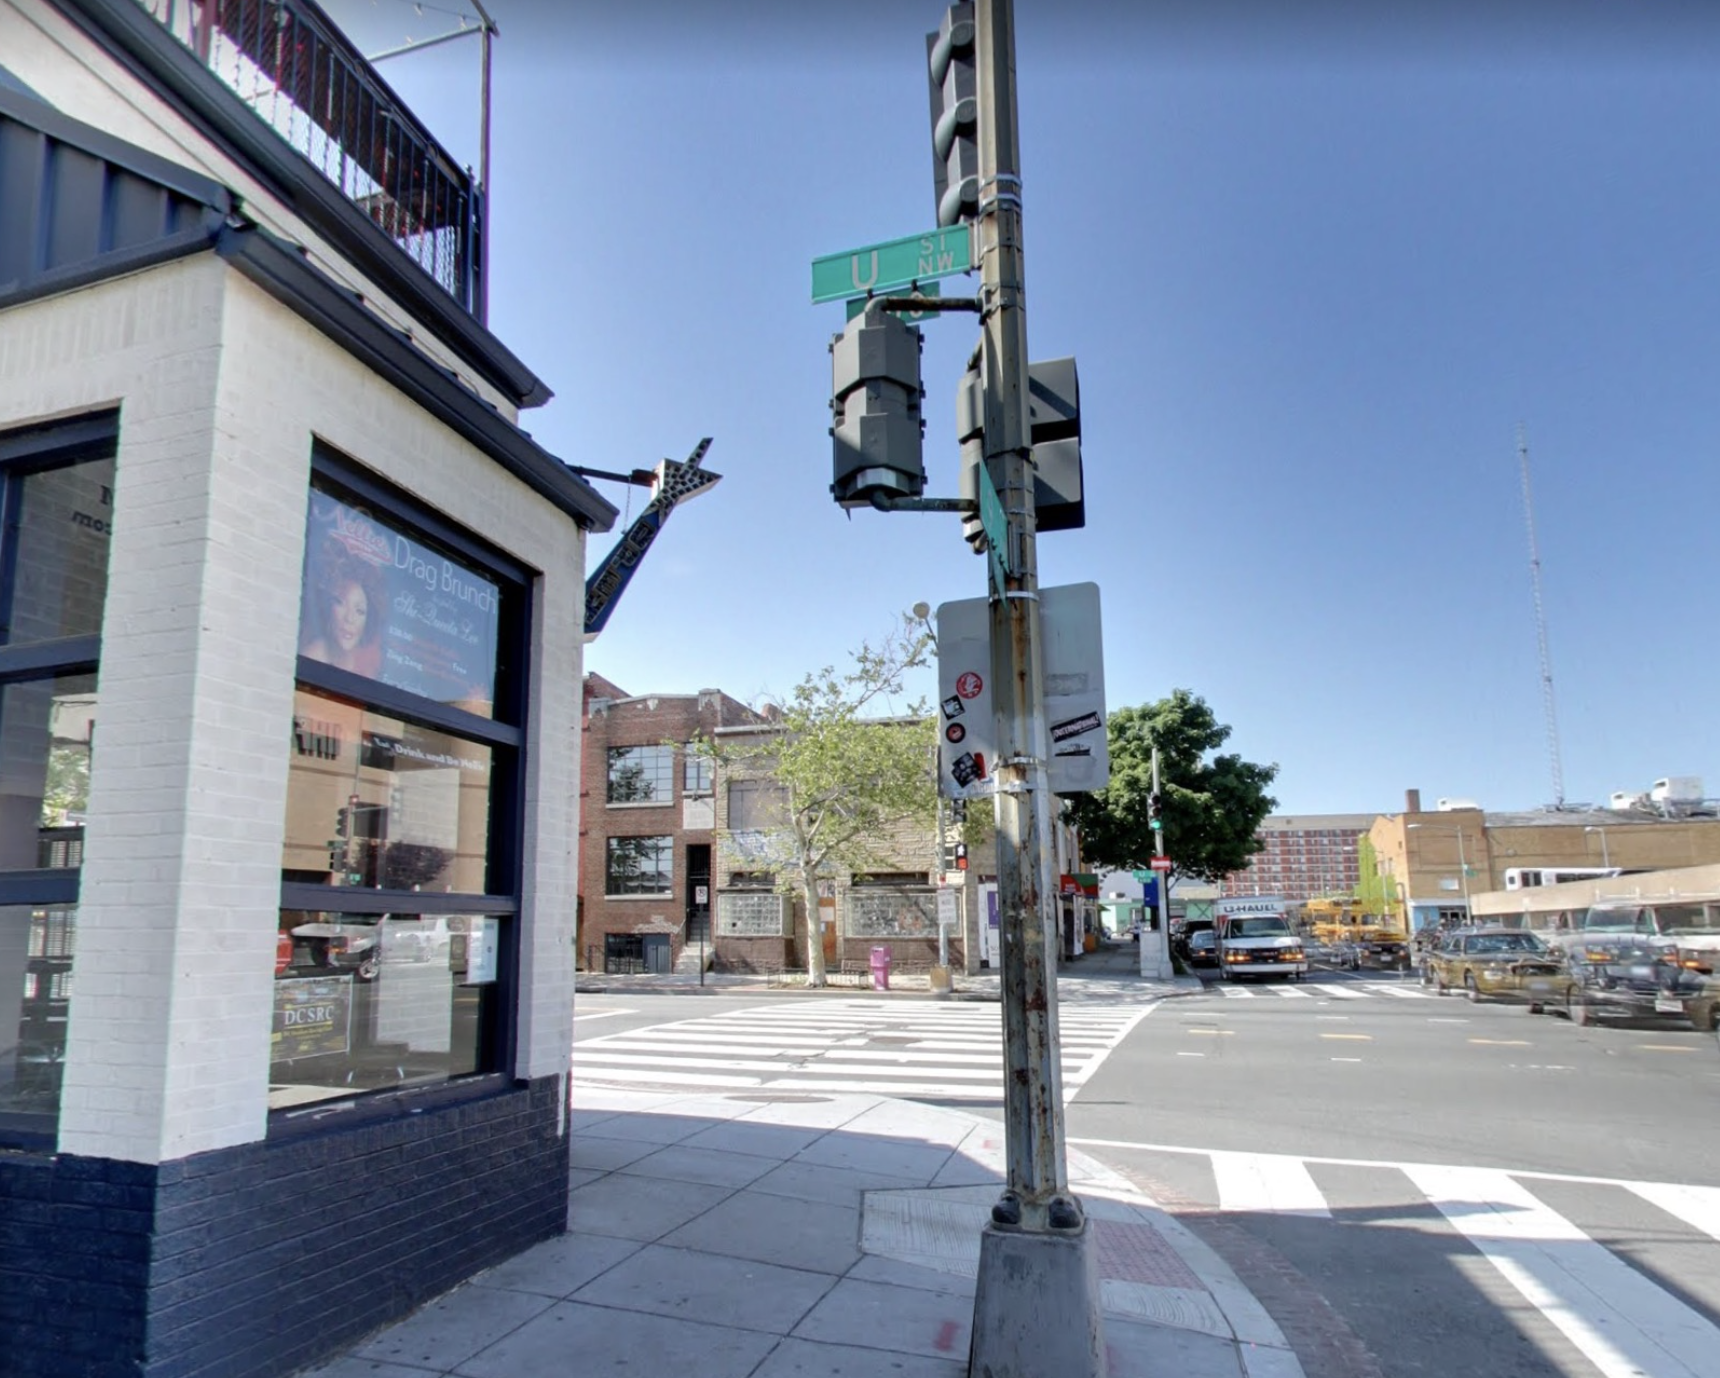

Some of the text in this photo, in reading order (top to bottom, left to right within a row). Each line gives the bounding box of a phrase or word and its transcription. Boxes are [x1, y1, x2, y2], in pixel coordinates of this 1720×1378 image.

[852, 250, 878, 290] U
[918, 251, 954, 277] NW
[394, 535, 438, 591] Drag
[441, 560, 497, 615] Brunch
[393, 743, 425, 760] Drink
[426, 753, 446, 764] and
[284, 1005, 335, 1026] DCSRC
